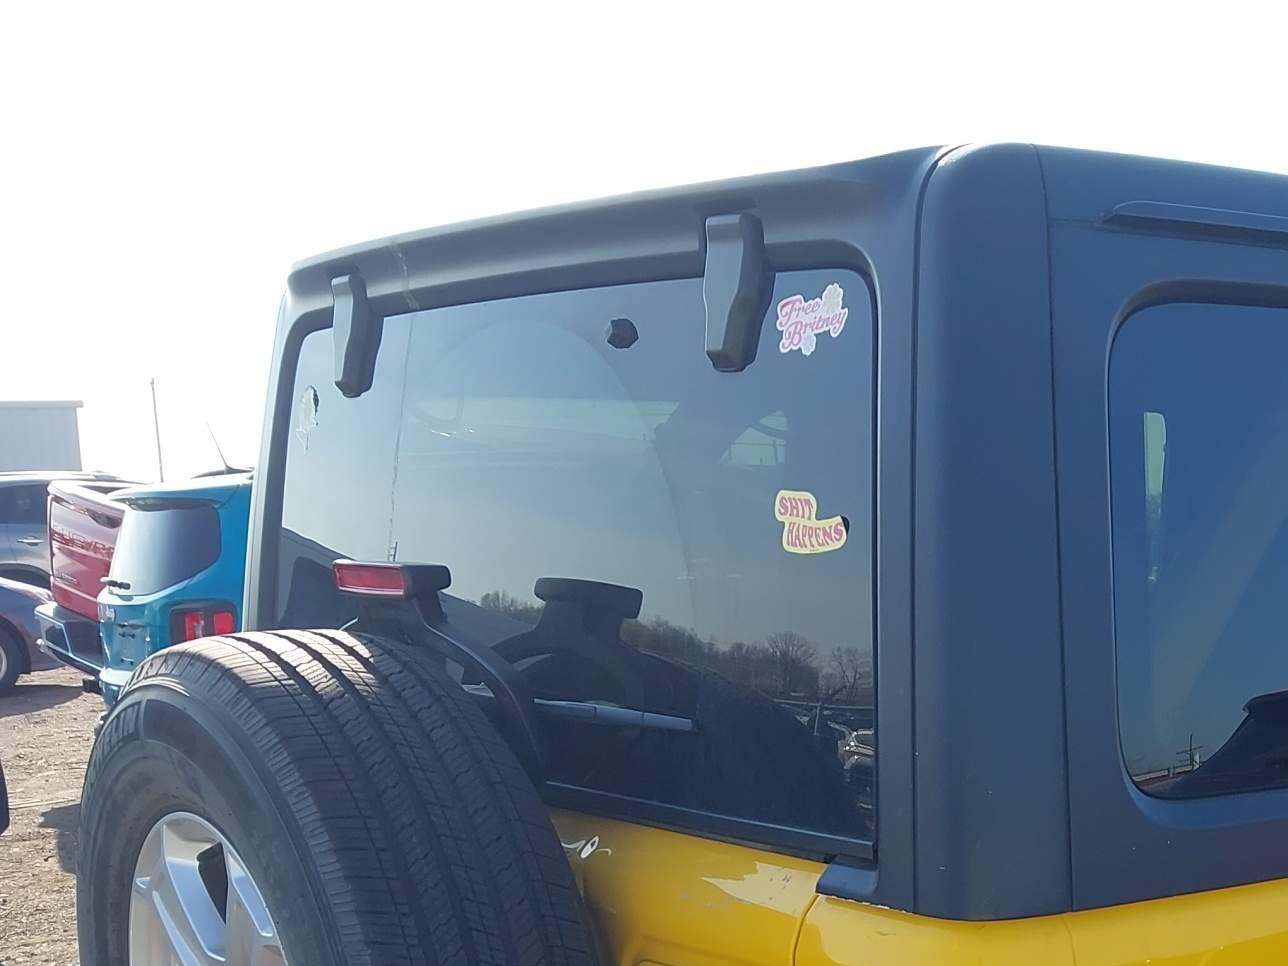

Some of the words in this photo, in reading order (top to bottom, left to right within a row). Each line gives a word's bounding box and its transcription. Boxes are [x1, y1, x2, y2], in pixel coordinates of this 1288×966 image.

[780, 298, 820, 327] Free
[781, 310, 847, 350] Britney
[778, 495, 814, 521] SHIT
[786, 522, 844, 549] HAPPENS
